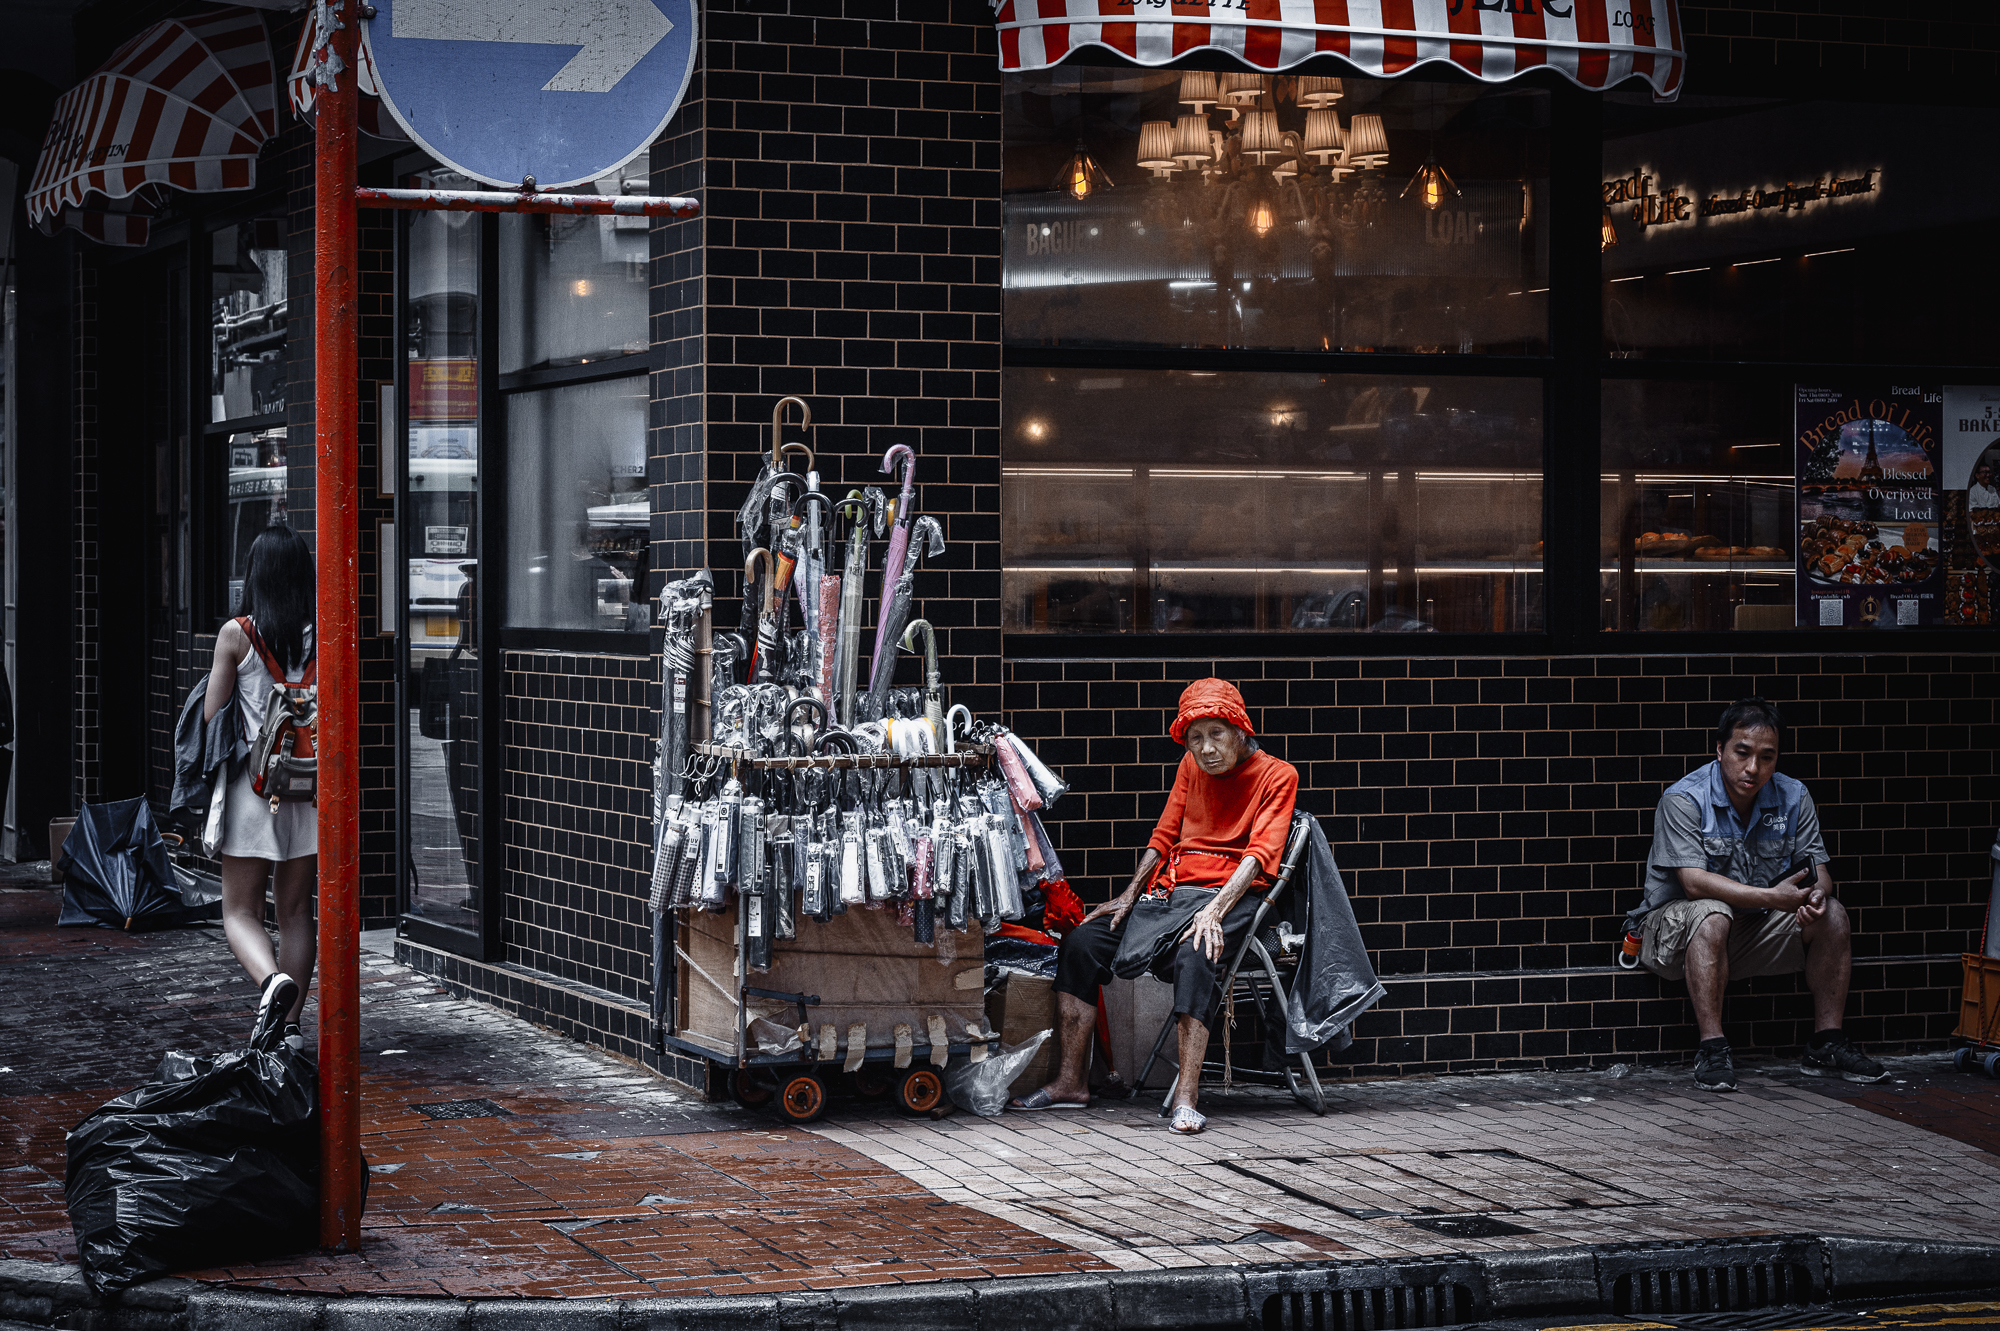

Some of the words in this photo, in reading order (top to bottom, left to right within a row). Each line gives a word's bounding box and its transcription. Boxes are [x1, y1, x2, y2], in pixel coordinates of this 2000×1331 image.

[1612, 10, 1656, 35] LOAF
[1425, 209, 1481, 245] LOAF
[1891, 385, 1921, 396] Bread
[1923, 393, 1943, 404] Life
[1799, 399, 1863, 452] Bread
[1869, 398, 1899, 422] Of
[1899, 408, 1936, 452] Life
[1882, 467, 1927, 480] Blessed
[1869, 487, 1932, 503] Overjoyed
[1895, 507, 1932, 520] Loved
